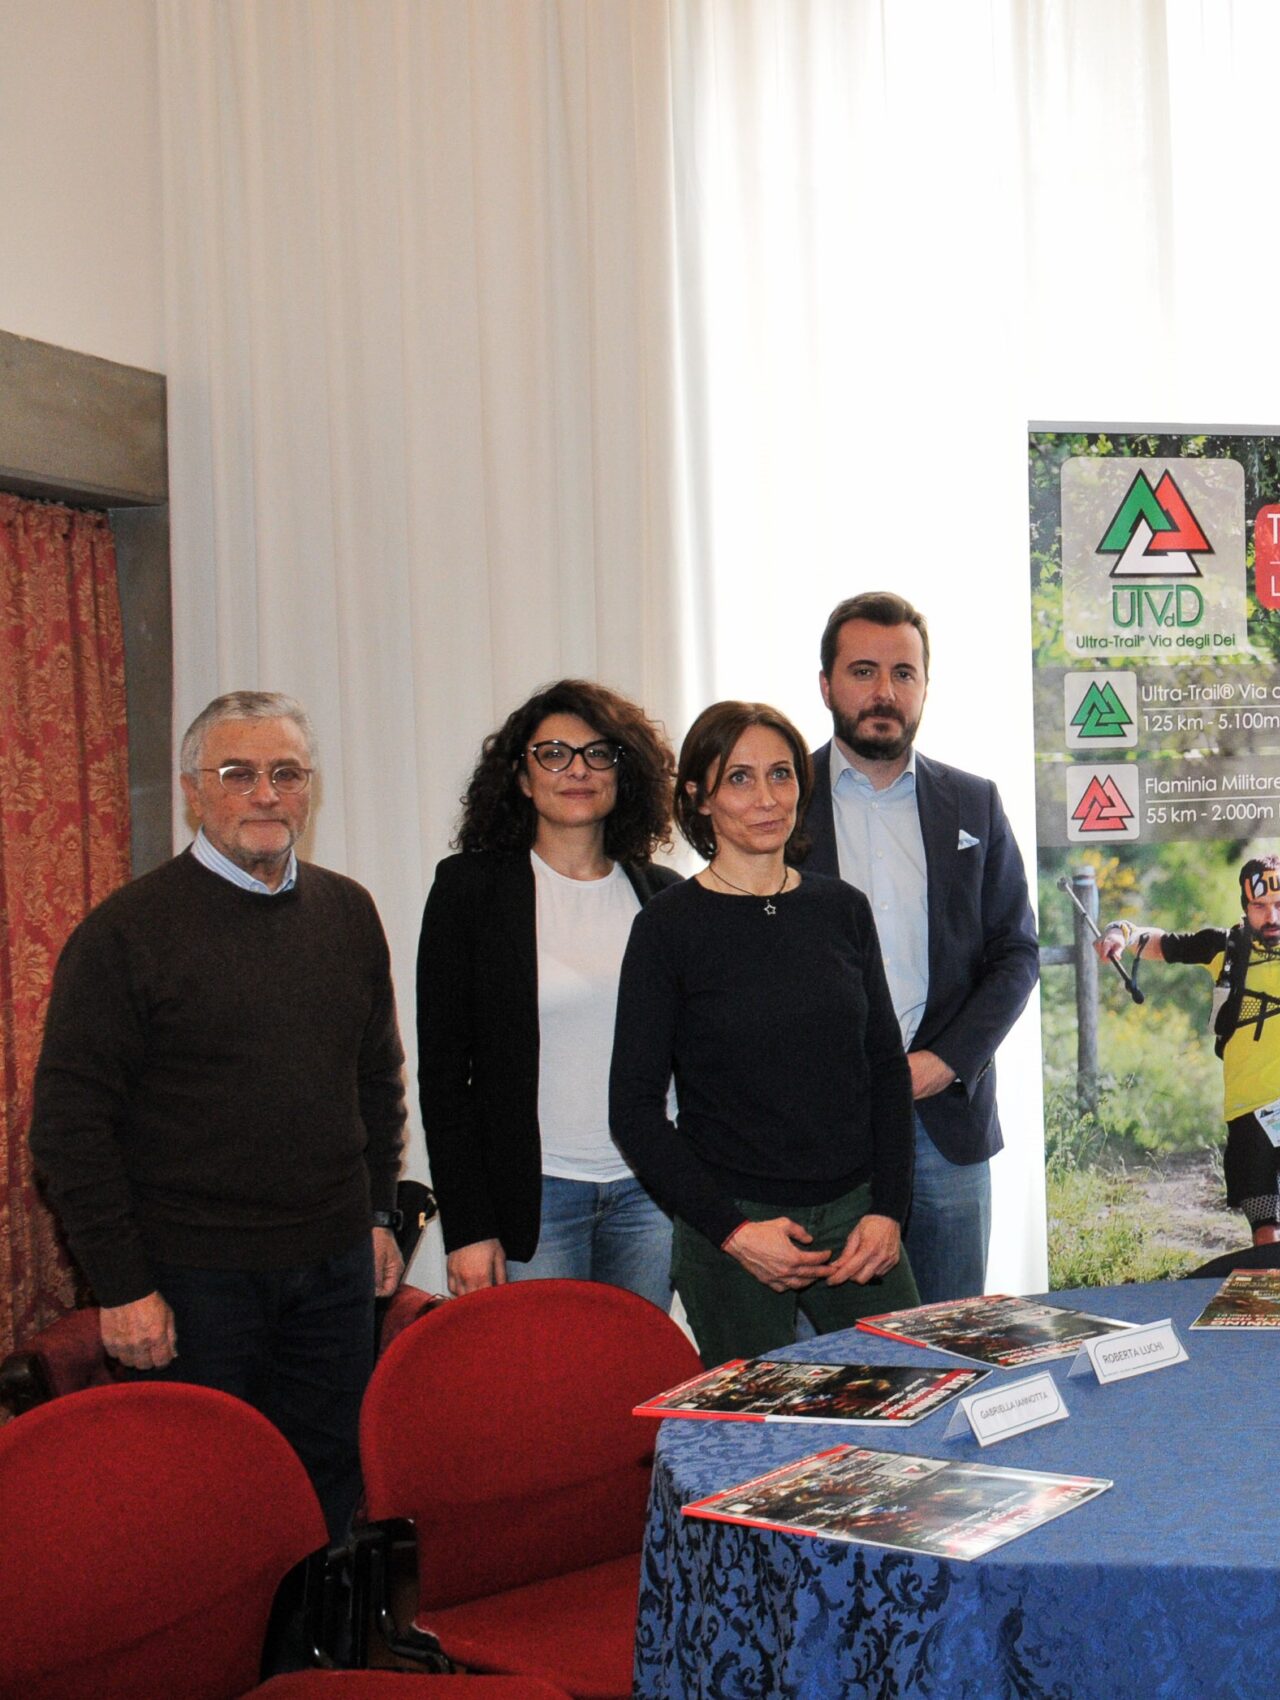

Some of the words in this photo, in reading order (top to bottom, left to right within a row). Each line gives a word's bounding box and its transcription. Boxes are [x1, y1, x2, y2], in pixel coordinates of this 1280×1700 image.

[1150, 634, 1172, 648] Via
[1176, 634, 1210, 650] degli
[1213, 633, 1236, 647] Dei
[1141, 683, 1235, 702] Ultra-Trail®
[1238, 684, 1267, 700] Via
[1143, 715, 1173, 732] 125
[1177, 715, 1203, 731] km
[1218, 712, 1280, 730] 5.100m
[1145, 776, 1217, 795] Flaminia
[1146, 807, 1167, 824] 55
[1171, 806, 1196, 822] km
[1212, 803, 1274, 821] 2.000m
[1102, 1348, 1139, 1364] ROBERTA
[1140, 1341, 1164, 1356] LUCHI
[980, 1402, 1015, 1420] GABRIELLA
[1015, 1391, 1048, 1408] IANNOTTA
